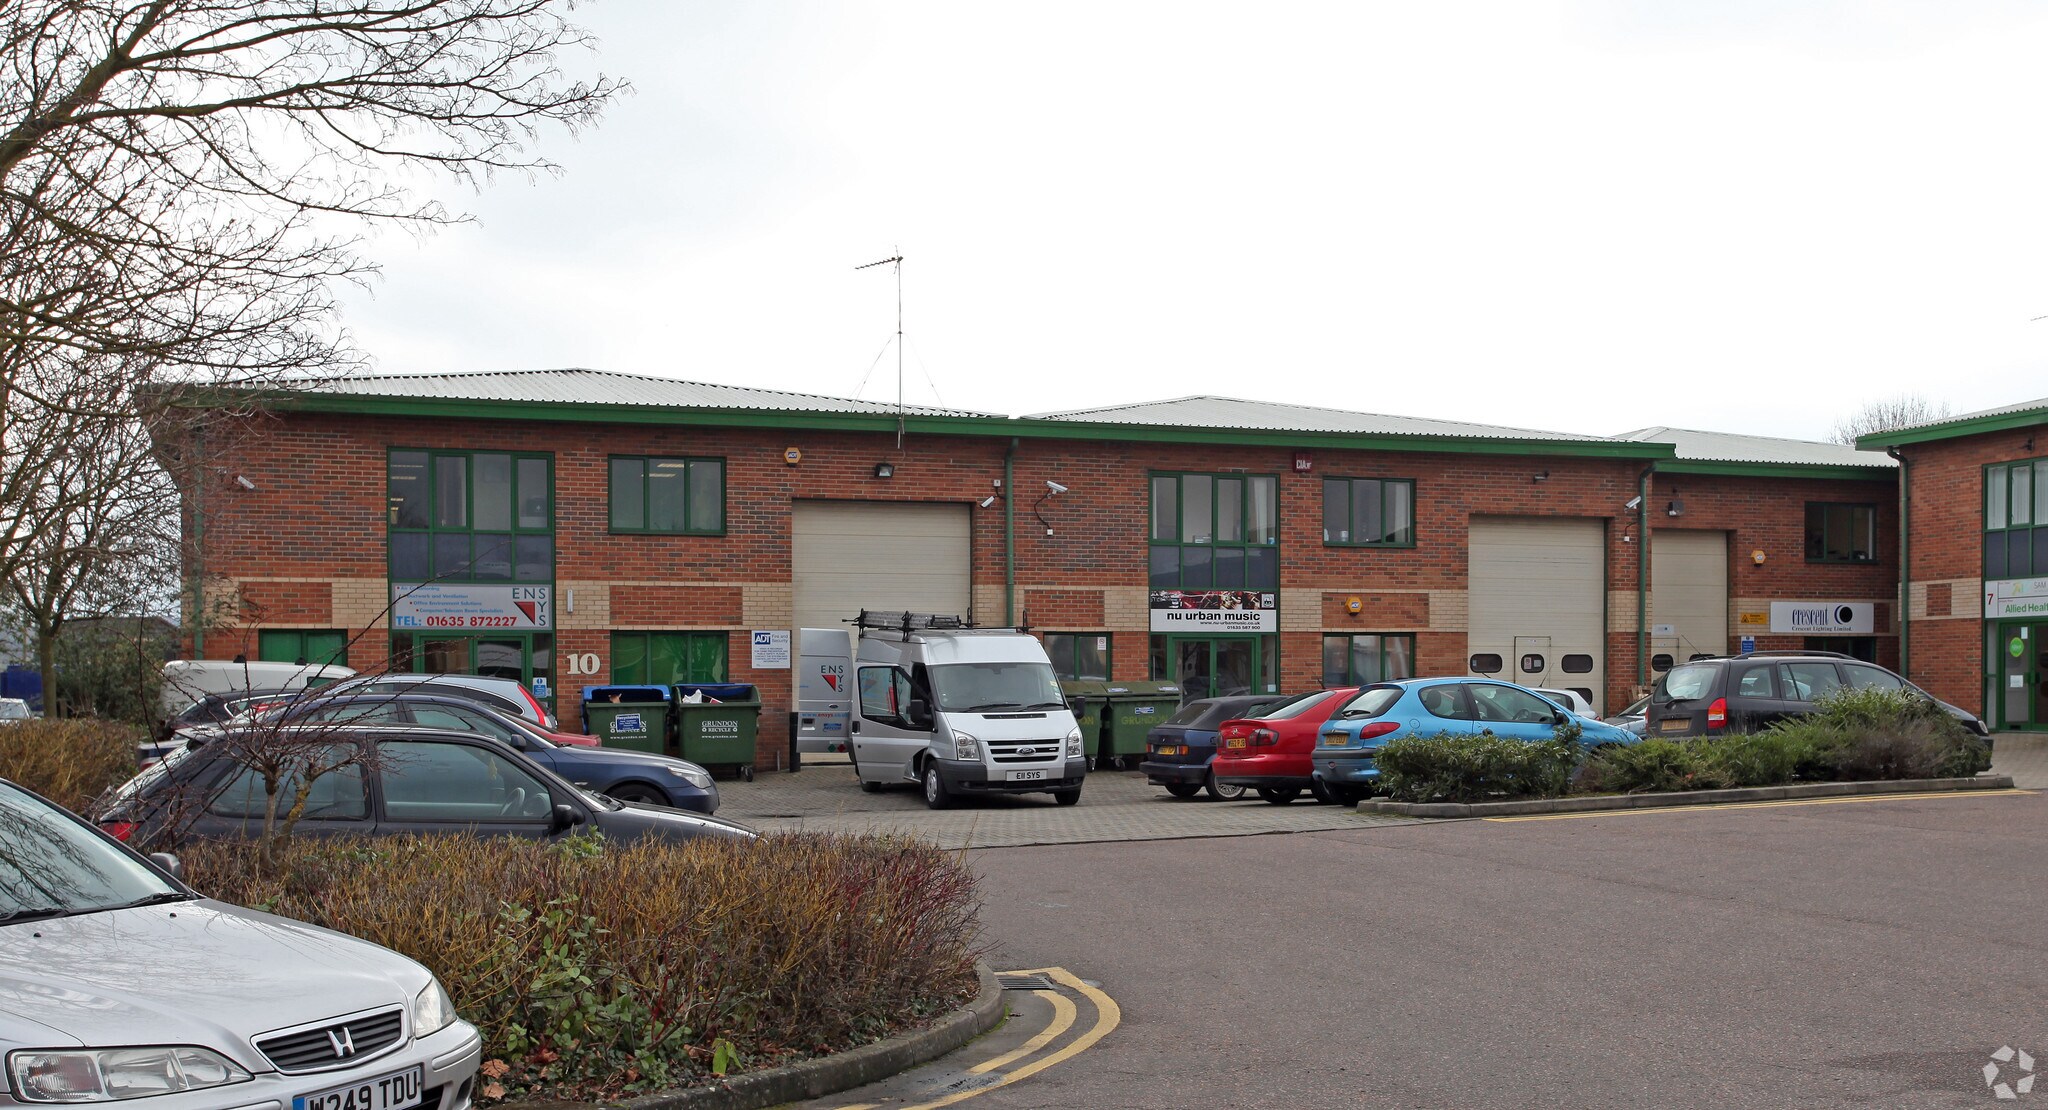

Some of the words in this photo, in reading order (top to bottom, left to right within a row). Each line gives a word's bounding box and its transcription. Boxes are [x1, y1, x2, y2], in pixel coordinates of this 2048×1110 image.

[1987, 593, 1994, 605] 7
[2005, 603, 2027, 613] Allied
[1185, 611, 1221, 621] urban
[1224, 611, 1260, 621] music
[1792, 604, 1829, 626] crescent
[396, 616, 422, 626] TEL:
[426, 616, 465, 627] 01635
[470, 616, 517, 627] 872227
[755, 634, 770, 643] ADT
[566, 653, 601, 675] 10
[701, 720, 738, 728] GRUNDON
[1026, 771, 1041, 779] SYS
[379, 1071, 417, 1109] TDU
